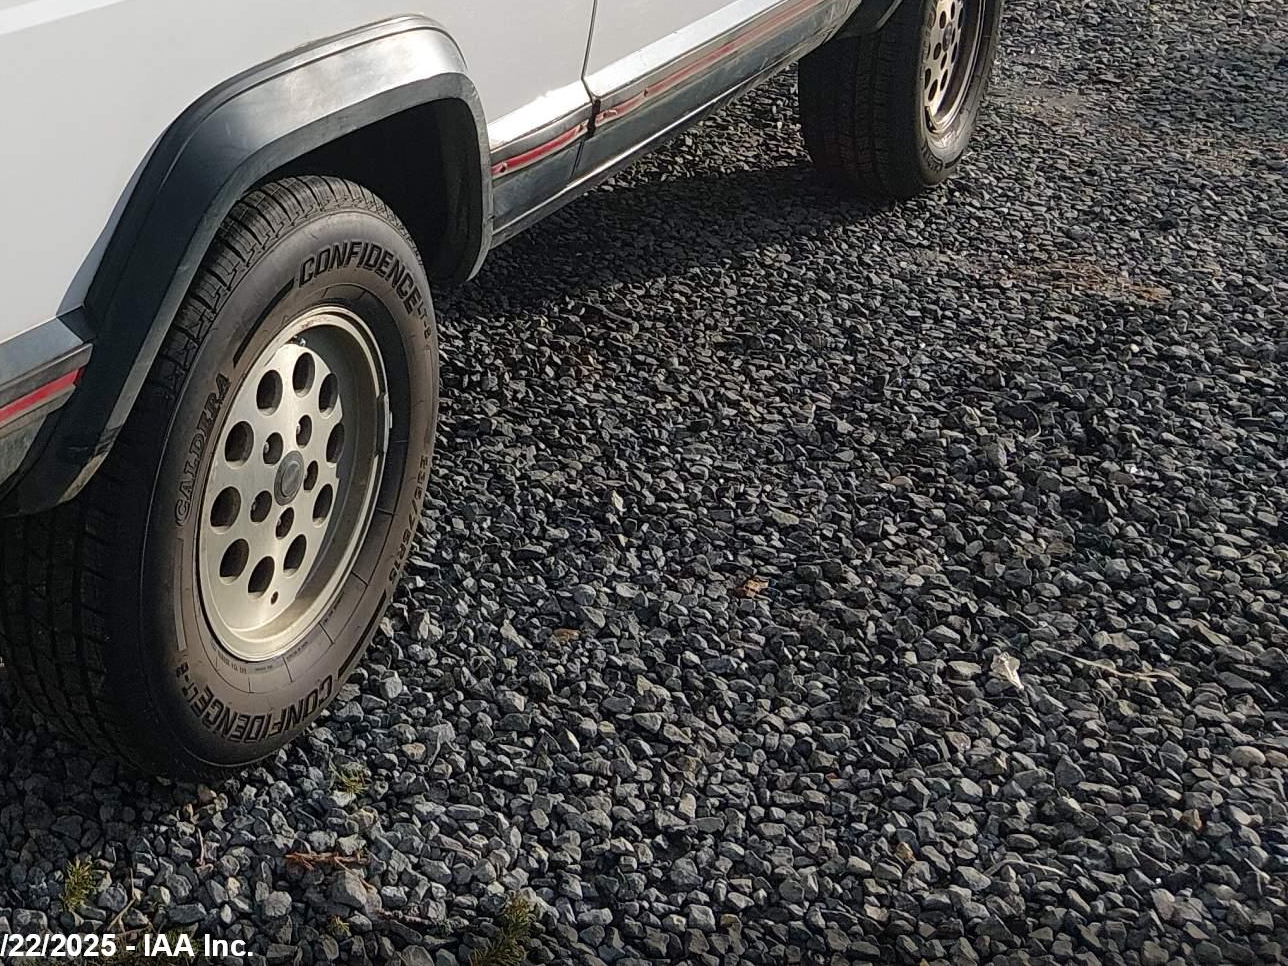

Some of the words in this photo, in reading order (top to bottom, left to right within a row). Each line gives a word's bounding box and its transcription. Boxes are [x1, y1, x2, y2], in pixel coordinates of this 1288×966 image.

[298, 240, 423, 315] CONFIDENCE
[174, 372, 231, 527] CALDERA
[190, 674, 333, 744] CONFIDENCE
